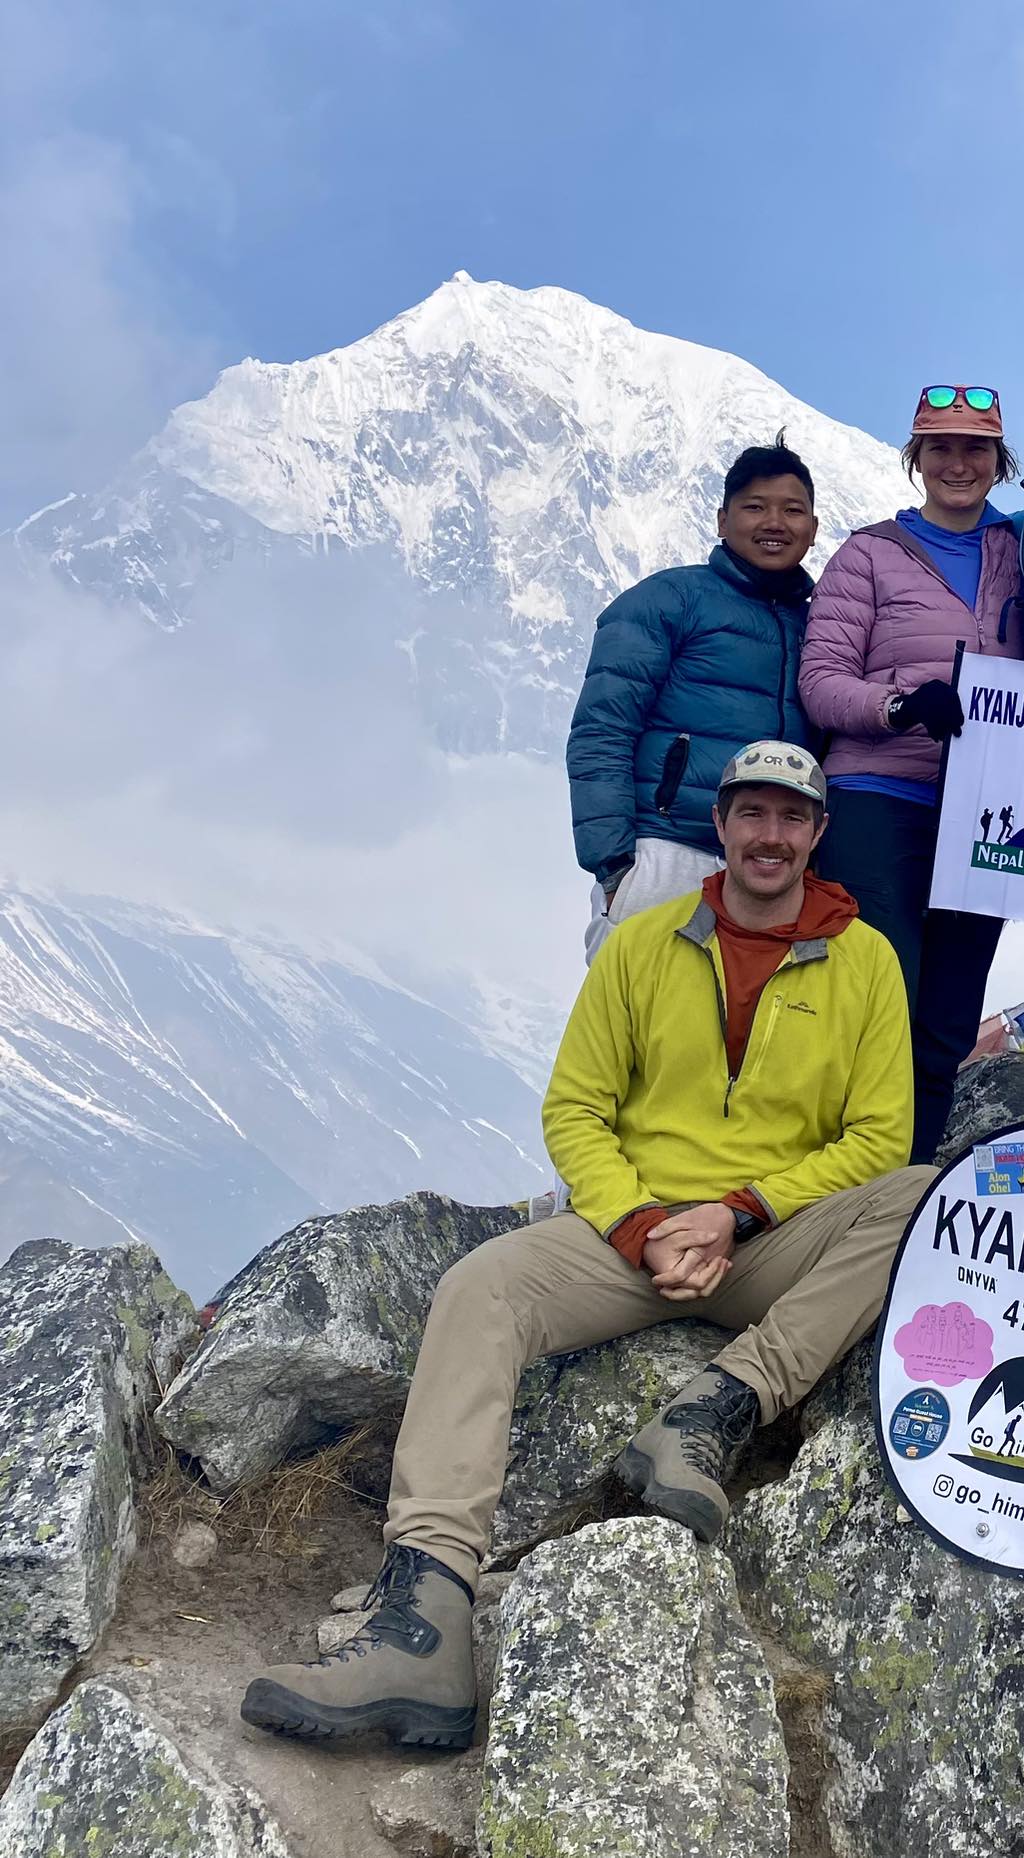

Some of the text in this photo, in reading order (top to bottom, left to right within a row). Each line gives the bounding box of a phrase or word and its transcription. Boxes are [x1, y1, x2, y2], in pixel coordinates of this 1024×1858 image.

[764, 755, 783, 766] OR
[988, 1171, 1010, 1182] Alon
[970, 1427, 994, 1448] Go
